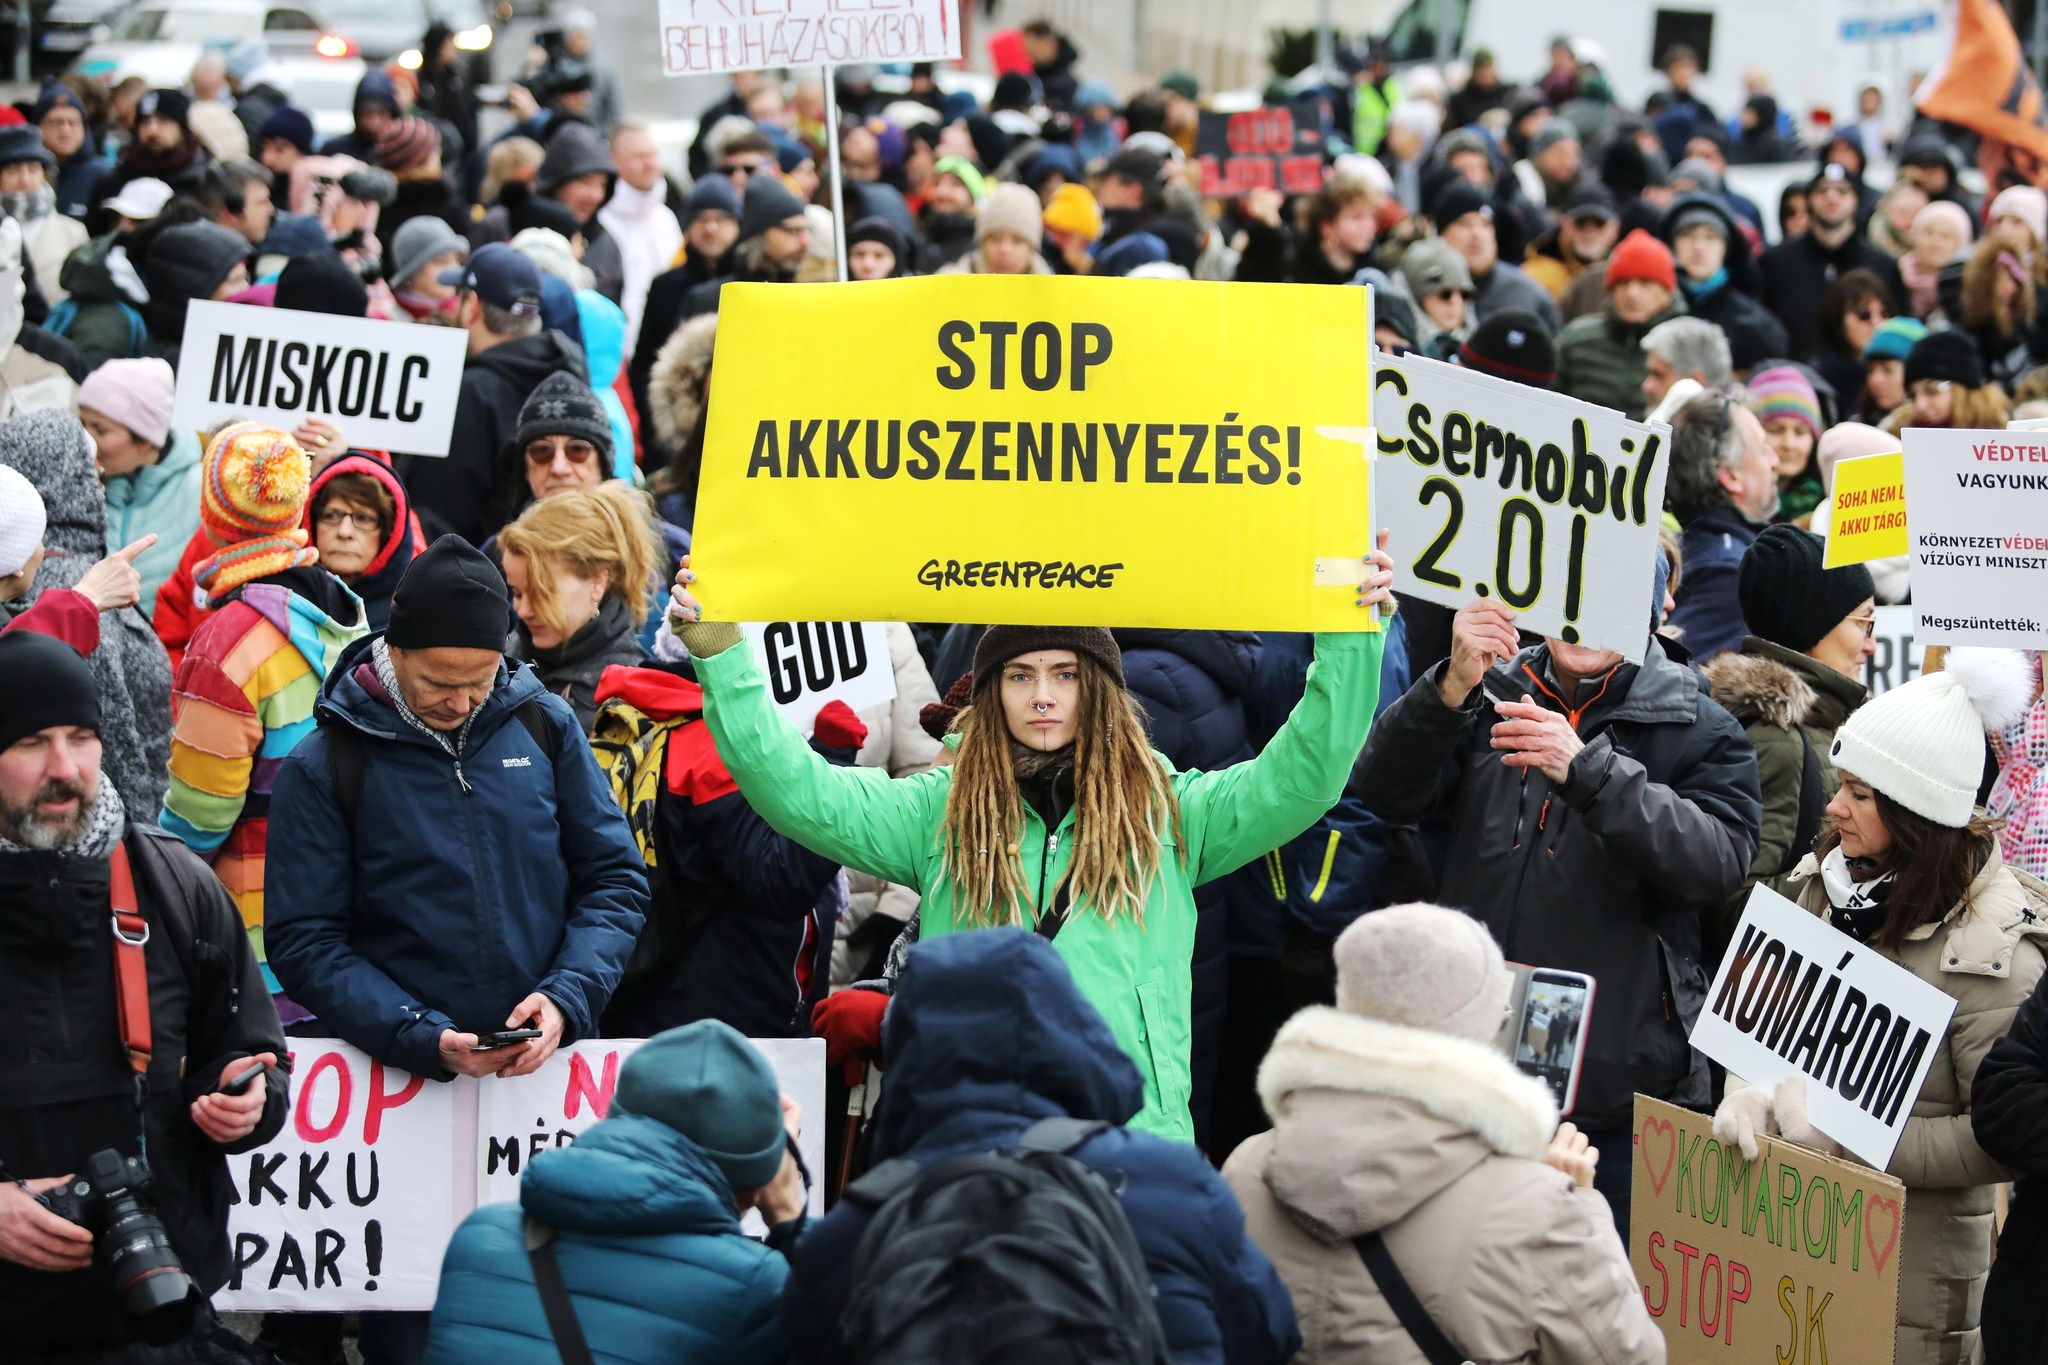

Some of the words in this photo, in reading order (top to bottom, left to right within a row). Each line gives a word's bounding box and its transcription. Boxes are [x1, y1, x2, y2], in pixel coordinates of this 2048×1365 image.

[208, 333, 430, 423] MISKOLC
[936, 319, 1114, 393] STOP
[746, 411, 1302, 486] AKKUSZENNYEZÉS!
[1375, 368, 1661, 527] Csernobil
[1956, 473, 2048, 490] VAGYUNK
[1837, 490, 1868, 511] SOHA
[1870, 485, 1896, 505] NEM
[1839, 517, 1871, 537] AKKU
[917, 558, 1125, 590] GREENPEACE
[1412, 475, 1588, 647] 2.0!
[1919, 550, 1981, 567] VÍZÜGYI
[1985, 556, 2048, 570] MINISZT
[1921, 614, 2041, 632] Megszüntették:
[1711, 922, 1932, 1128] KOMÁROM
[288, 1051, 426, 1145] OP
[230, 1150, 380, 1210] KKU
[1676, 1128, 1863, 1271] KOMÁROM
[1644, 1231, 1752, 1346] STOP
[1776, 1275, 1834, 1365] SK
